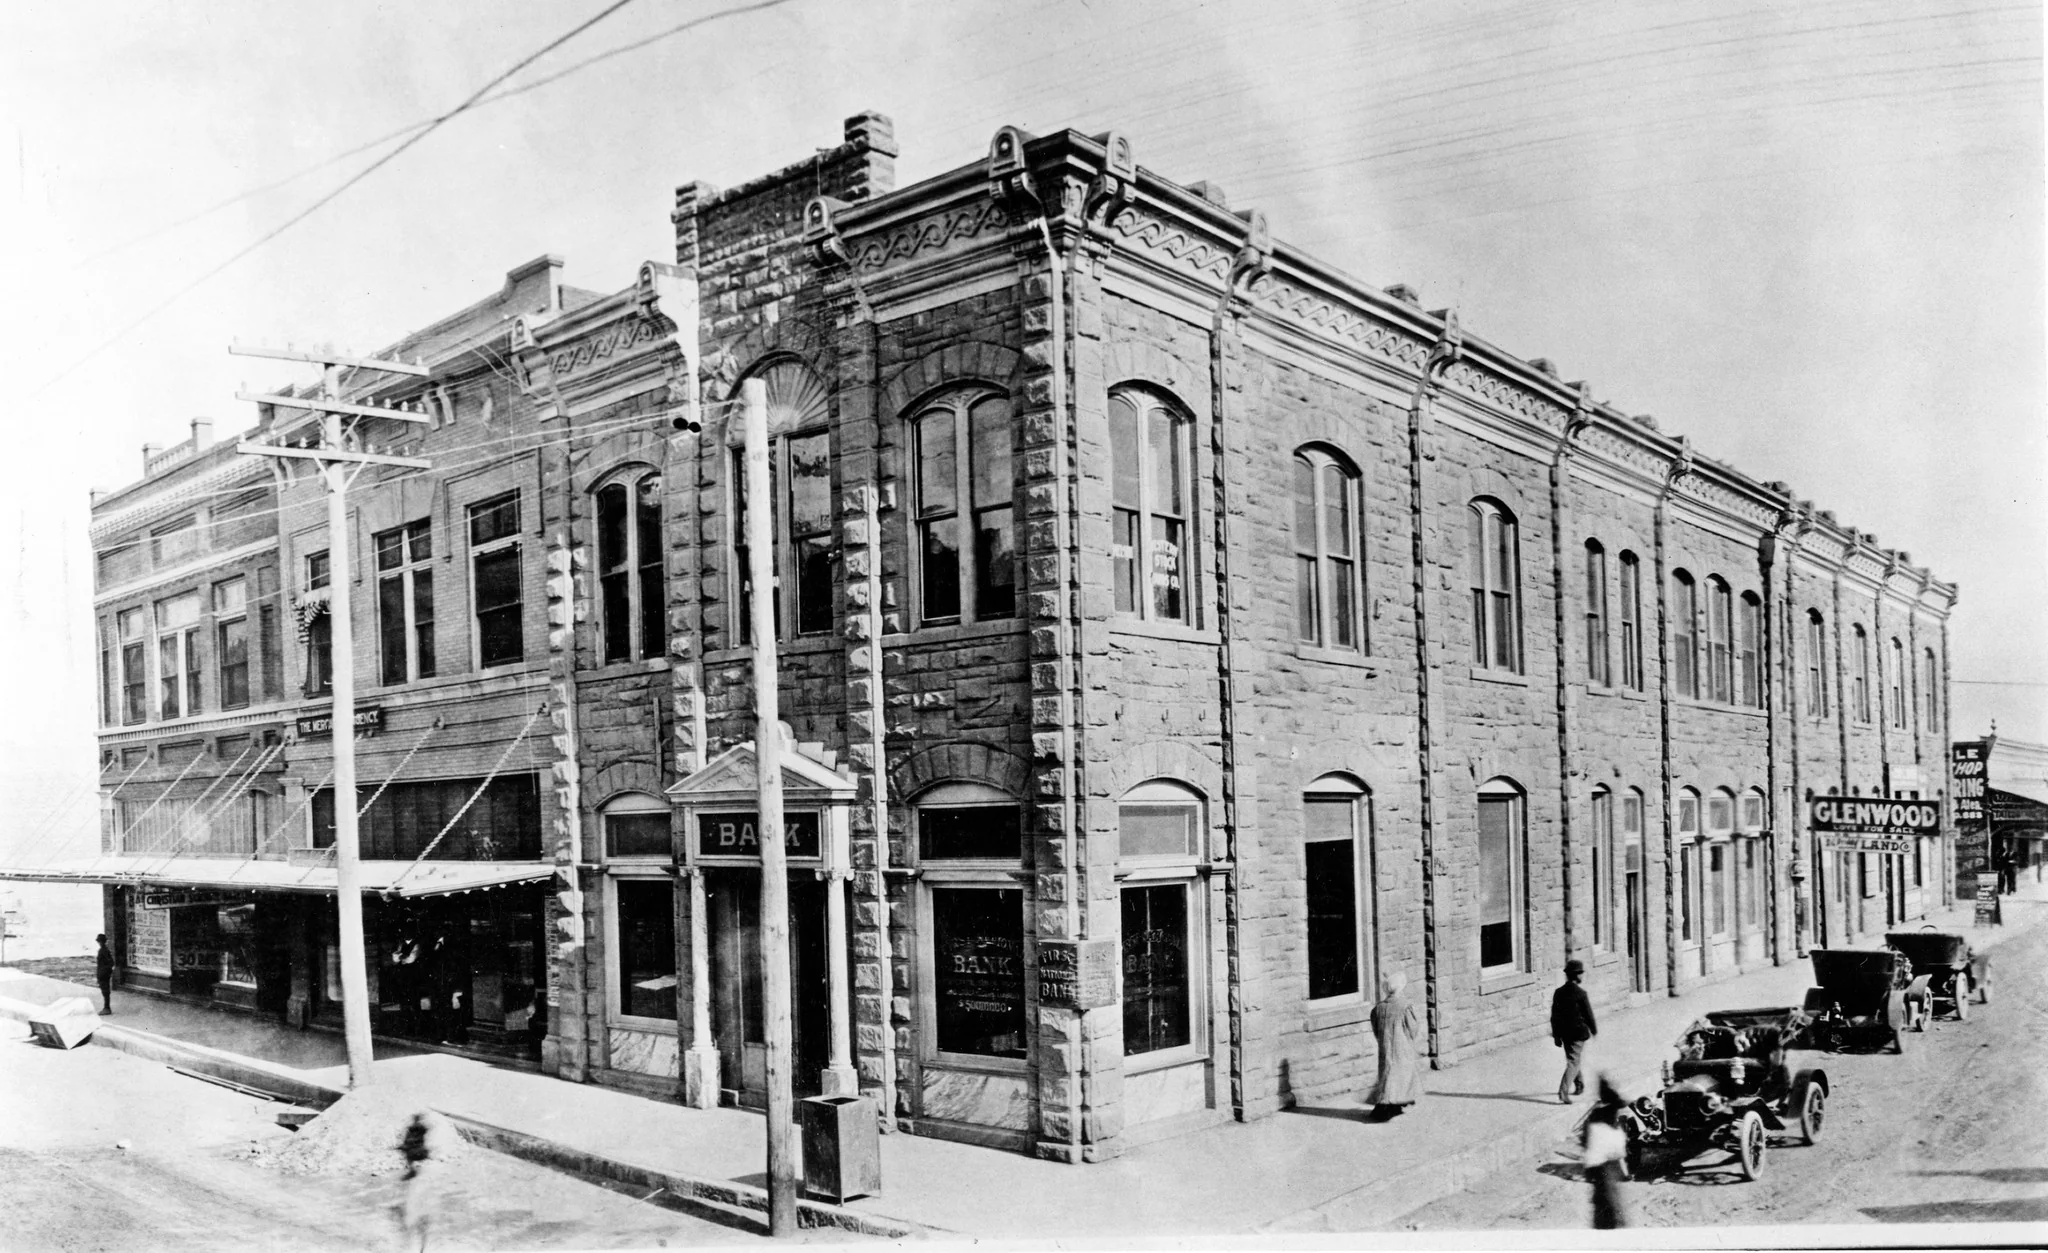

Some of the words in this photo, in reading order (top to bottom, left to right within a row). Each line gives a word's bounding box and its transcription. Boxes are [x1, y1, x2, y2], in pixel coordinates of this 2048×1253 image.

[299, 721, 312, 733] THE
[354, 710, 379, 725] GENCY
[1952, 761, 1984, 775] HOP
[1814, 801, 1937, 828] GLENWOOD
[719, 823, 801, 847] BAK
[1863, 825, 1884, 833] FOR
[1888, 826, 1915, 834] SALE
[1861, 840, 1899, 851] LAND
[953, 954, 1013, 976] BANK
